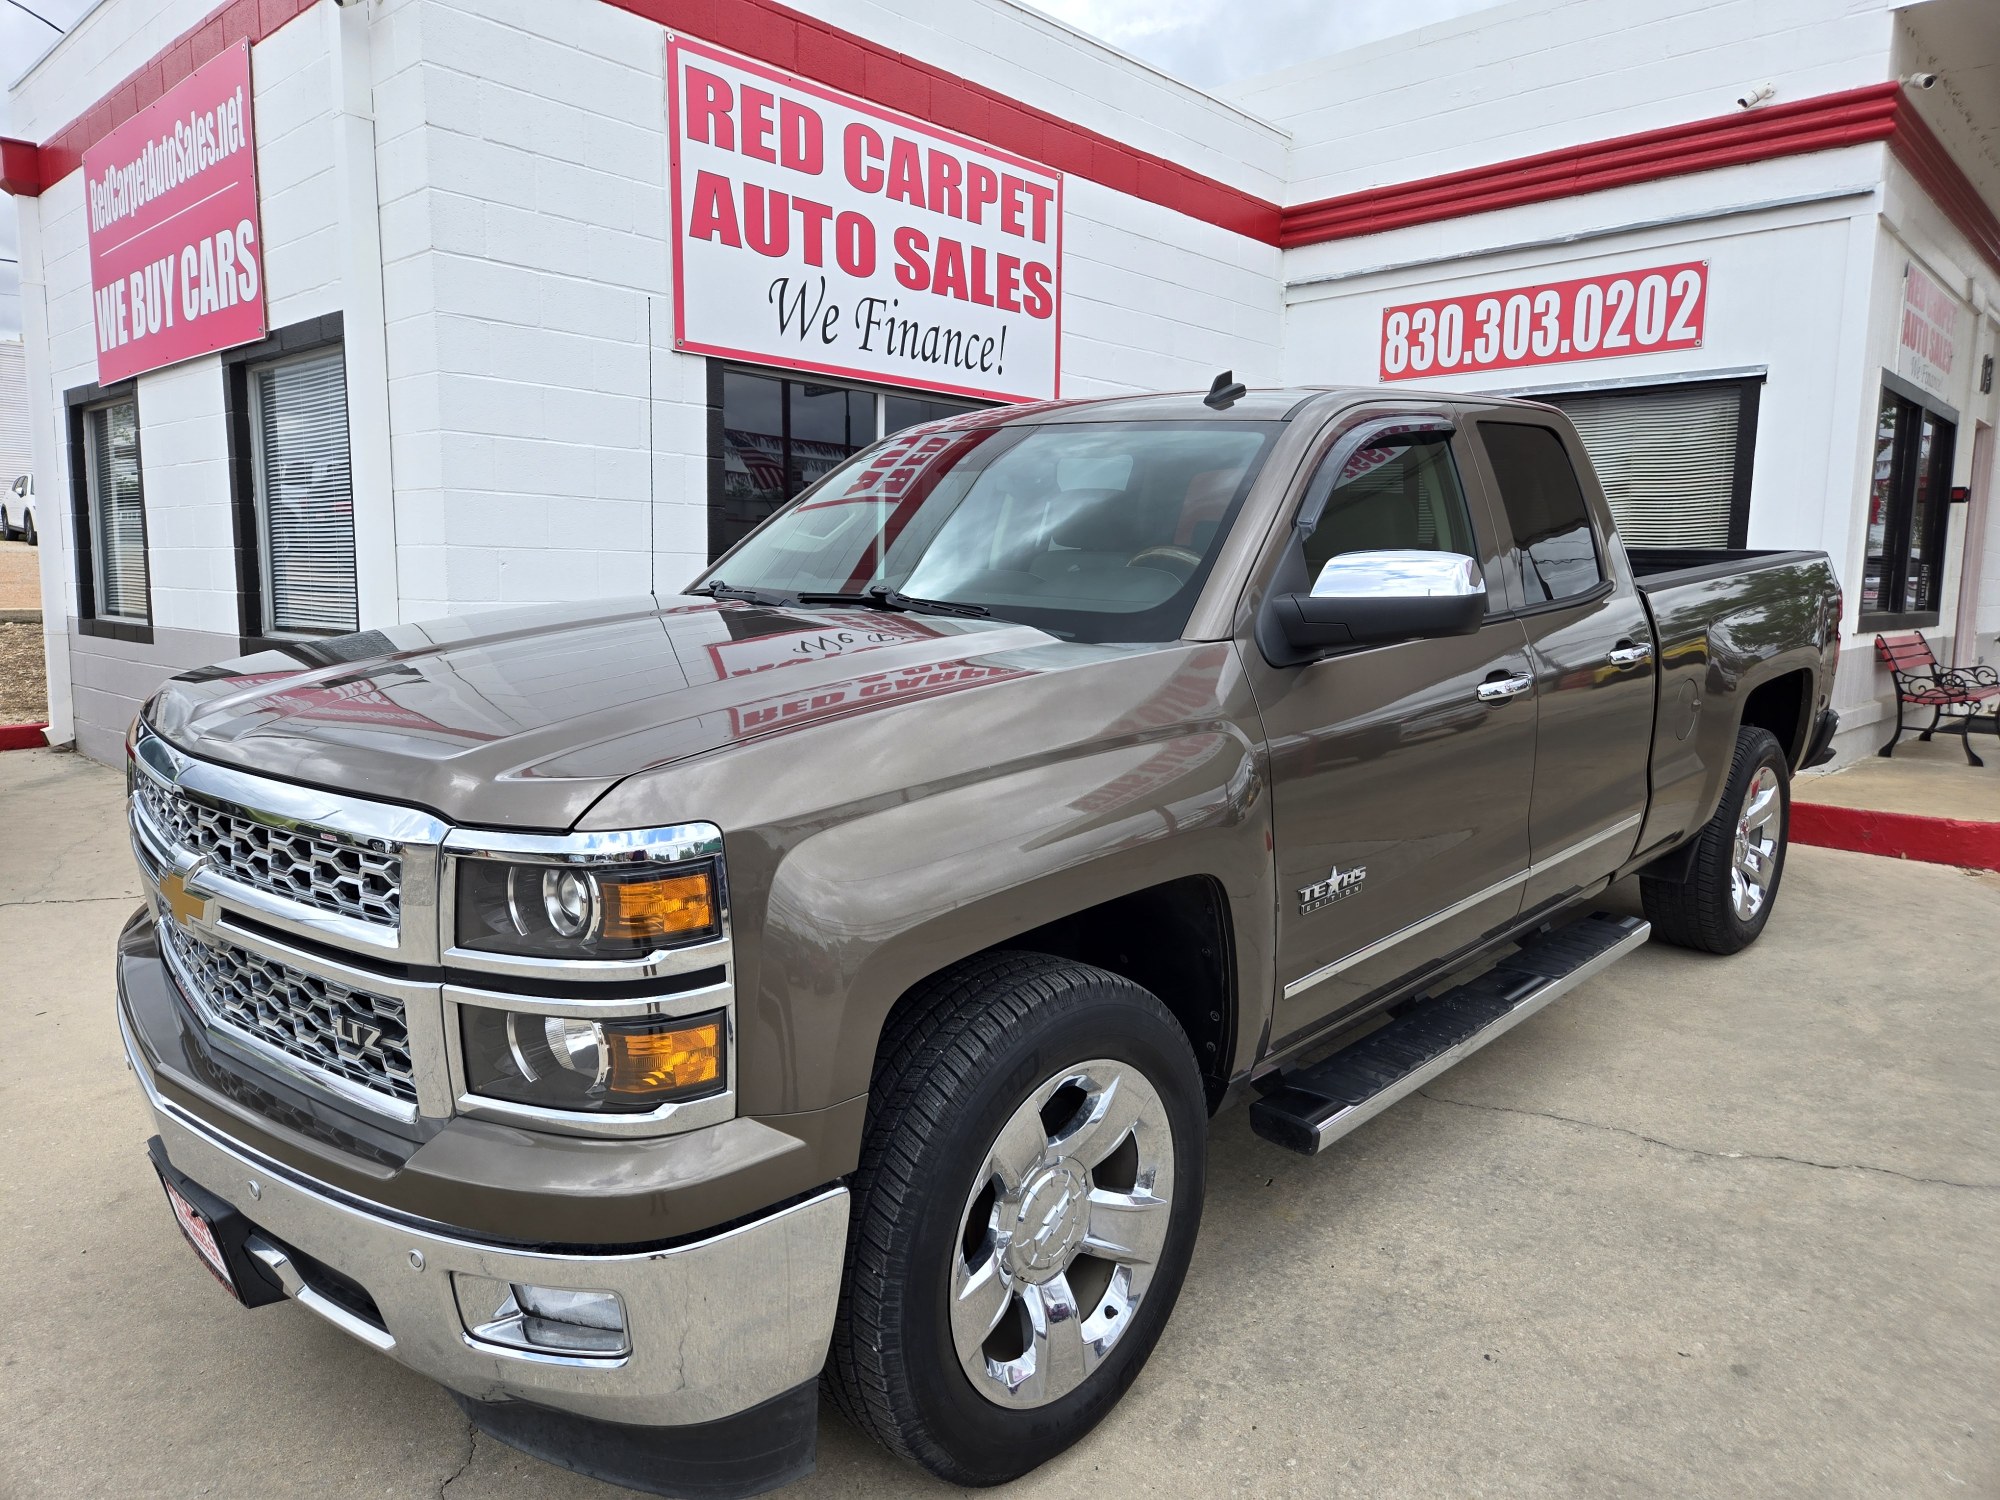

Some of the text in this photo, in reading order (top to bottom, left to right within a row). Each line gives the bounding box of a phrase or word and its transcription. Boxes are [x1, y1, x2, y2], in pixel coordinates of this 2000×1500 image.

[89, 85, 246, 233] RedCarpetAutoSales.net
[685, 65, 1054, 244] RED CARPET
[95, 219, 258, 353] WE BUY CARS
[689, 169, 1054, 320] AUTO SALES
[768, 275, 1007, 375] We Finance!
[1384, 269, 1702, 374] 830.303.0202
[1901, 308, 1953, 375] AUTO SALES
[1298, 865, 1367, 903] TEXAS
[1305, 884, 1361, 912] EDITION
[335, 1014, 383, 1052] LTZ
